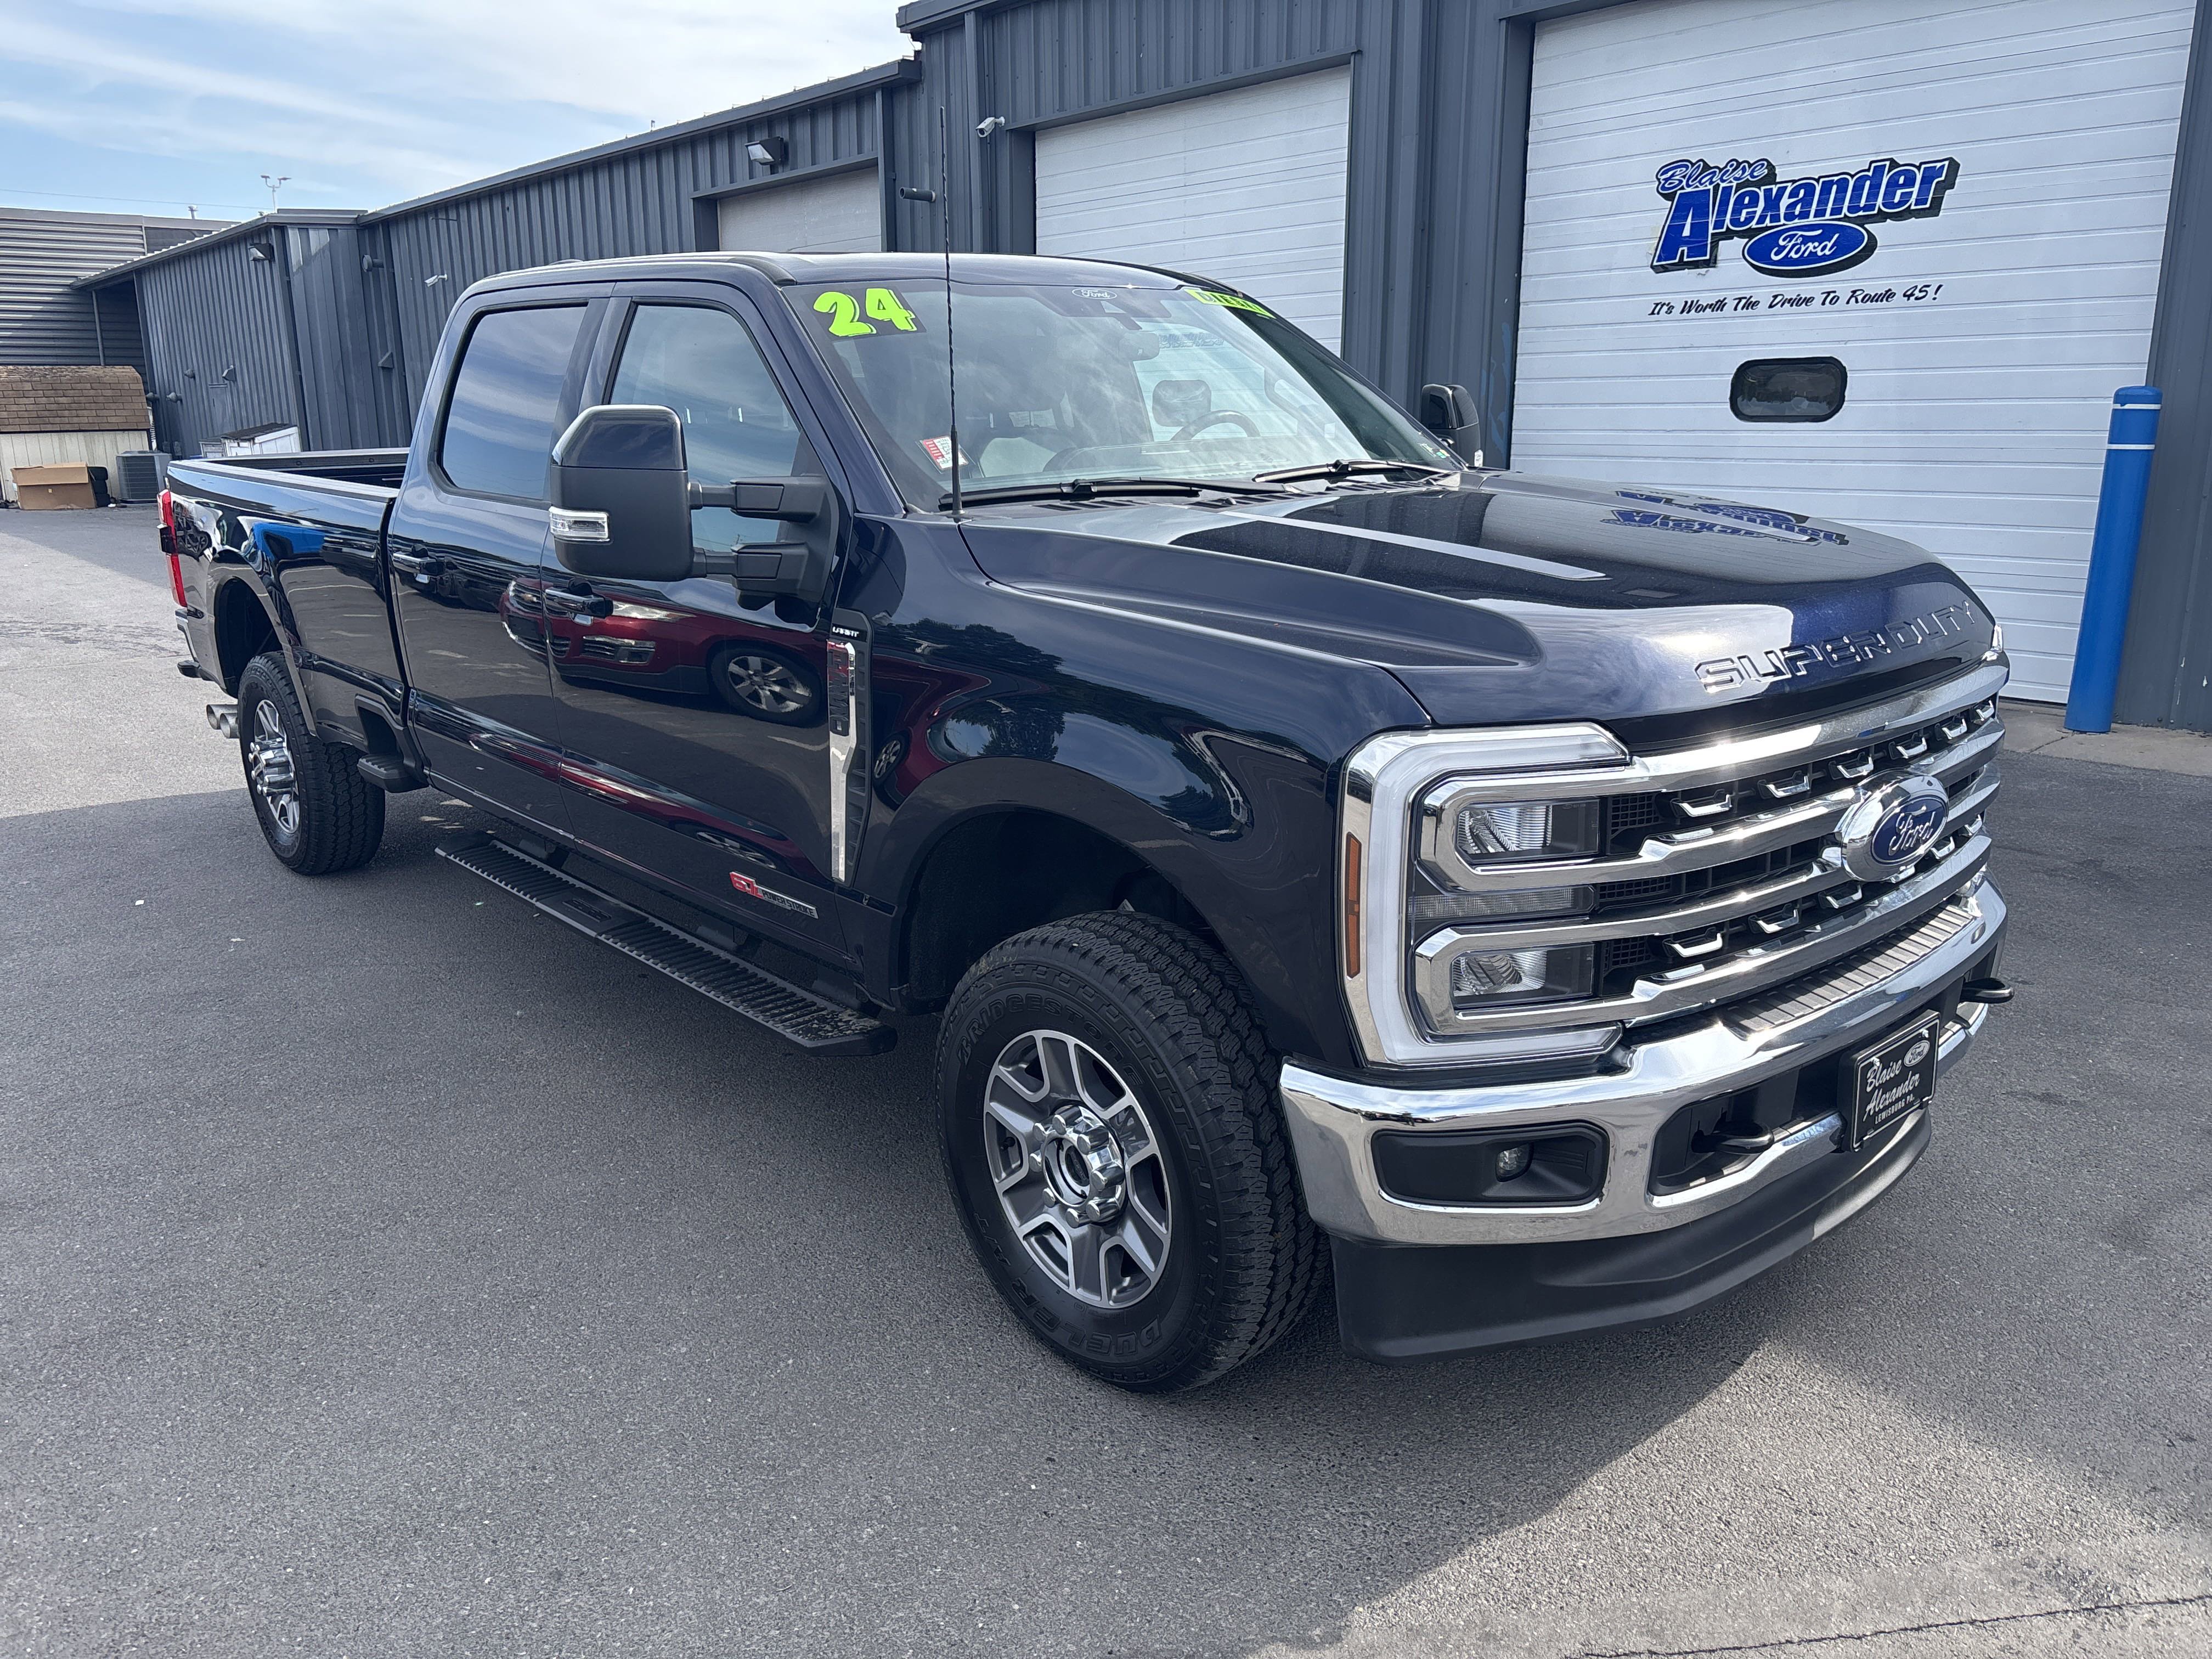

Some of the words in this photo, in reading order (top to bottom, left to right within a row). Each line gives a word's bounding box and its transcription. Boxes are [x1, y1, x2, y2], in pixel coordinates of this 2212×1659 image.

[1658, 160, 1769, 194] Blaise
[1652, 158, 1956, 268] Alexander
[1770, 229, 1837, 261] Ford
[1081, 289, 1111, 298] Ford
[1647, 301, 1674, 317] It's
[1679, 296, 1727, 315] Worth
[1733, 295, 1760, 312] The
[1768, 292, 1815, 309] Drive
[1820, 290, 1841, 307] To
[1846, 288, 1896, 306] Route
[813, 286, 918, 337] 24
[1694, 628, 1892, 694] SUPER
[1884, 600, 1976, 651] DUTY
[1888, 805, 1936, 856] Ford
[762, 889, 786, 905] POWER
[786, 900, 816, 917] STROKE
[956, 992, 1145, 1085] BRIDGESTONE
[1908, 1043, 1926, 1064] Ford
[1865, 1059, 1903, 1092] Blaise
[1863, 1070, 1921, 1122] Alexander
[1875, 1098, 1905, 1125] LEWISBURG
[1011, 1276, 1163, 1357] DUELER
